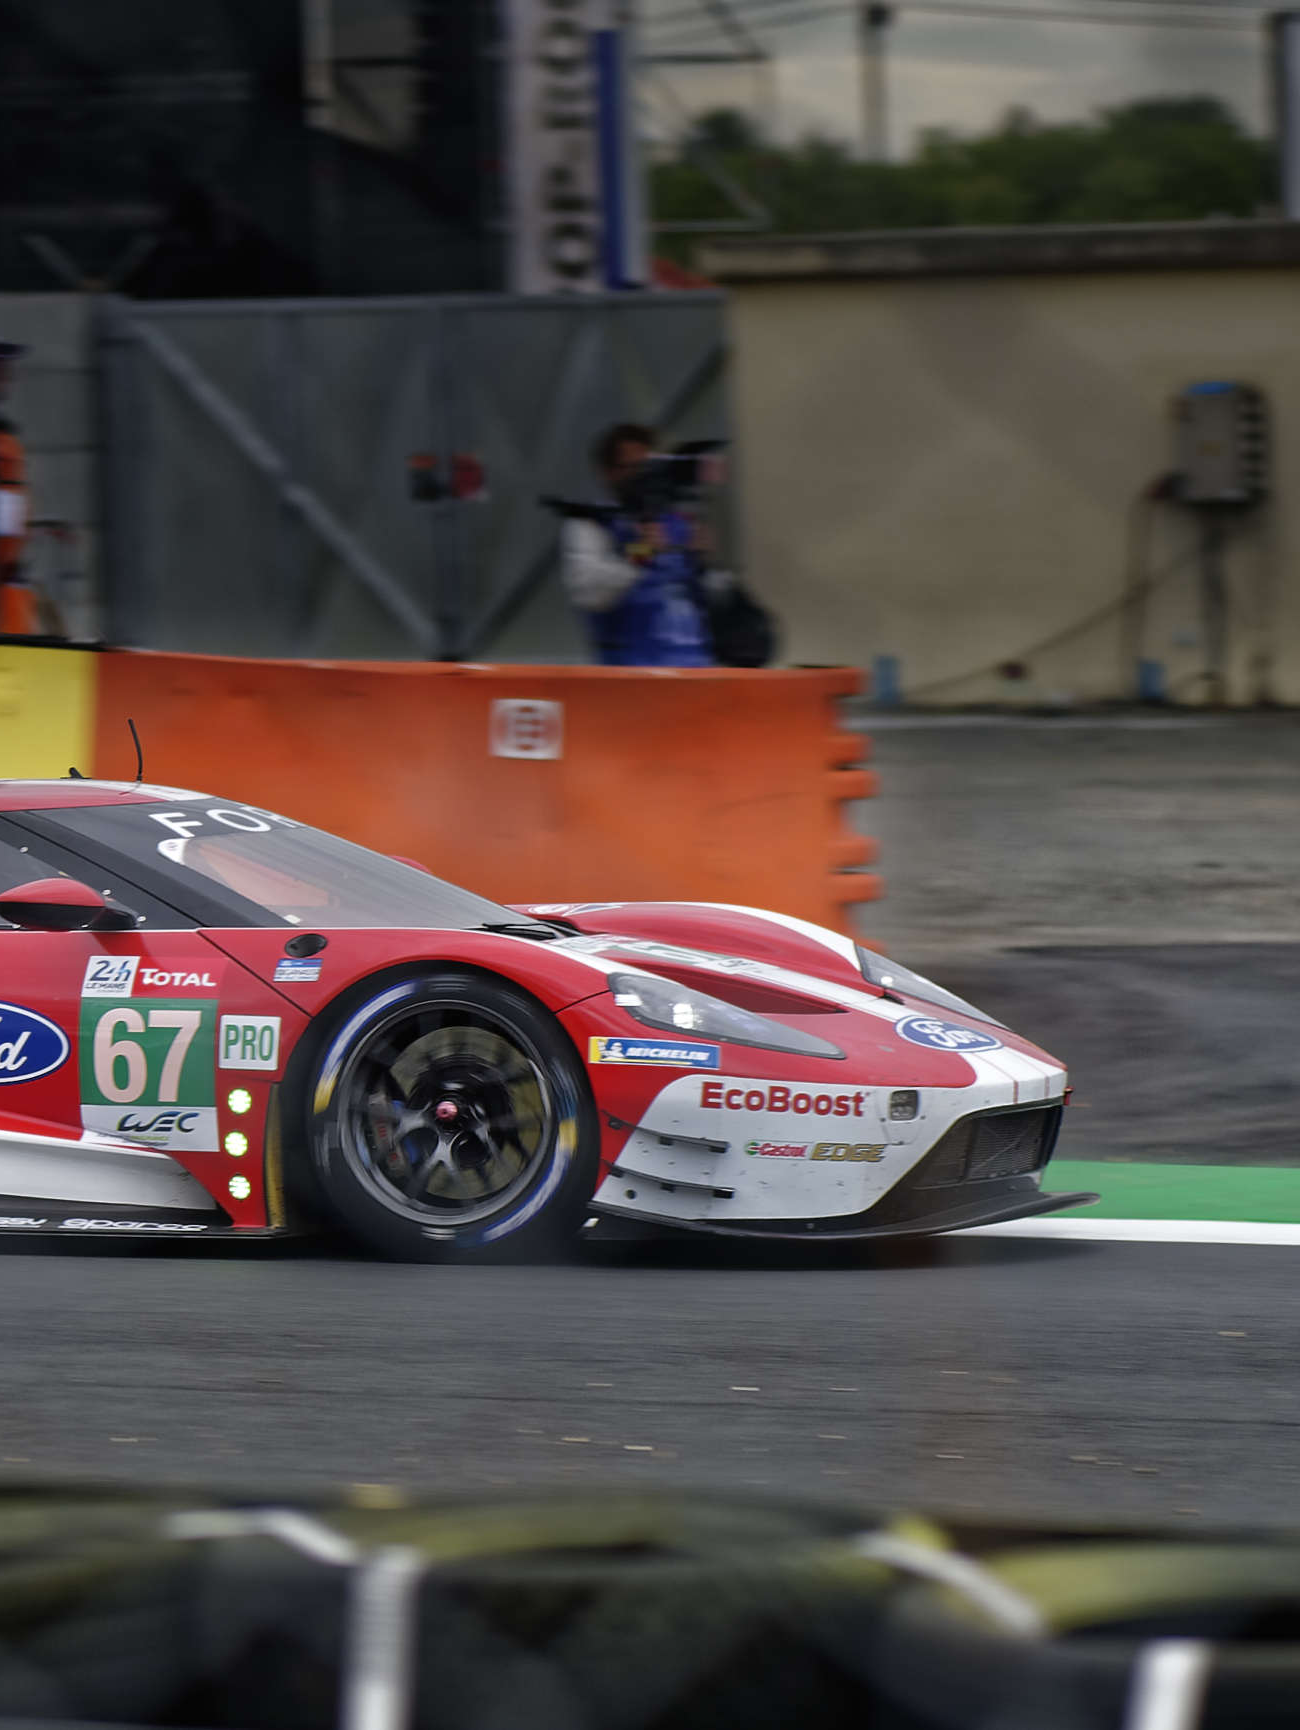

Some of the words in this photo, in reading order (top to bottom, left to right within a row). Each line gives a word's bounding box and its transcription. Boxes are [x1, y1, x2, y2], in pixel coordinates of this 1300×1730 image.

[139, 968, 217, 987] TOTAL
[223, 1024, 275, 1062] PRO
[625, 1046, 710, 1062] MICHELIN
[93, 1007, 203, 1104] 67
[700, 1081, 866, 1118] EcoBoost
[116, 1110, 201, 1133] WEC
[757, 1142, 808, 1158] Castrol
[809, 1141, 888, 1163] EDGE
